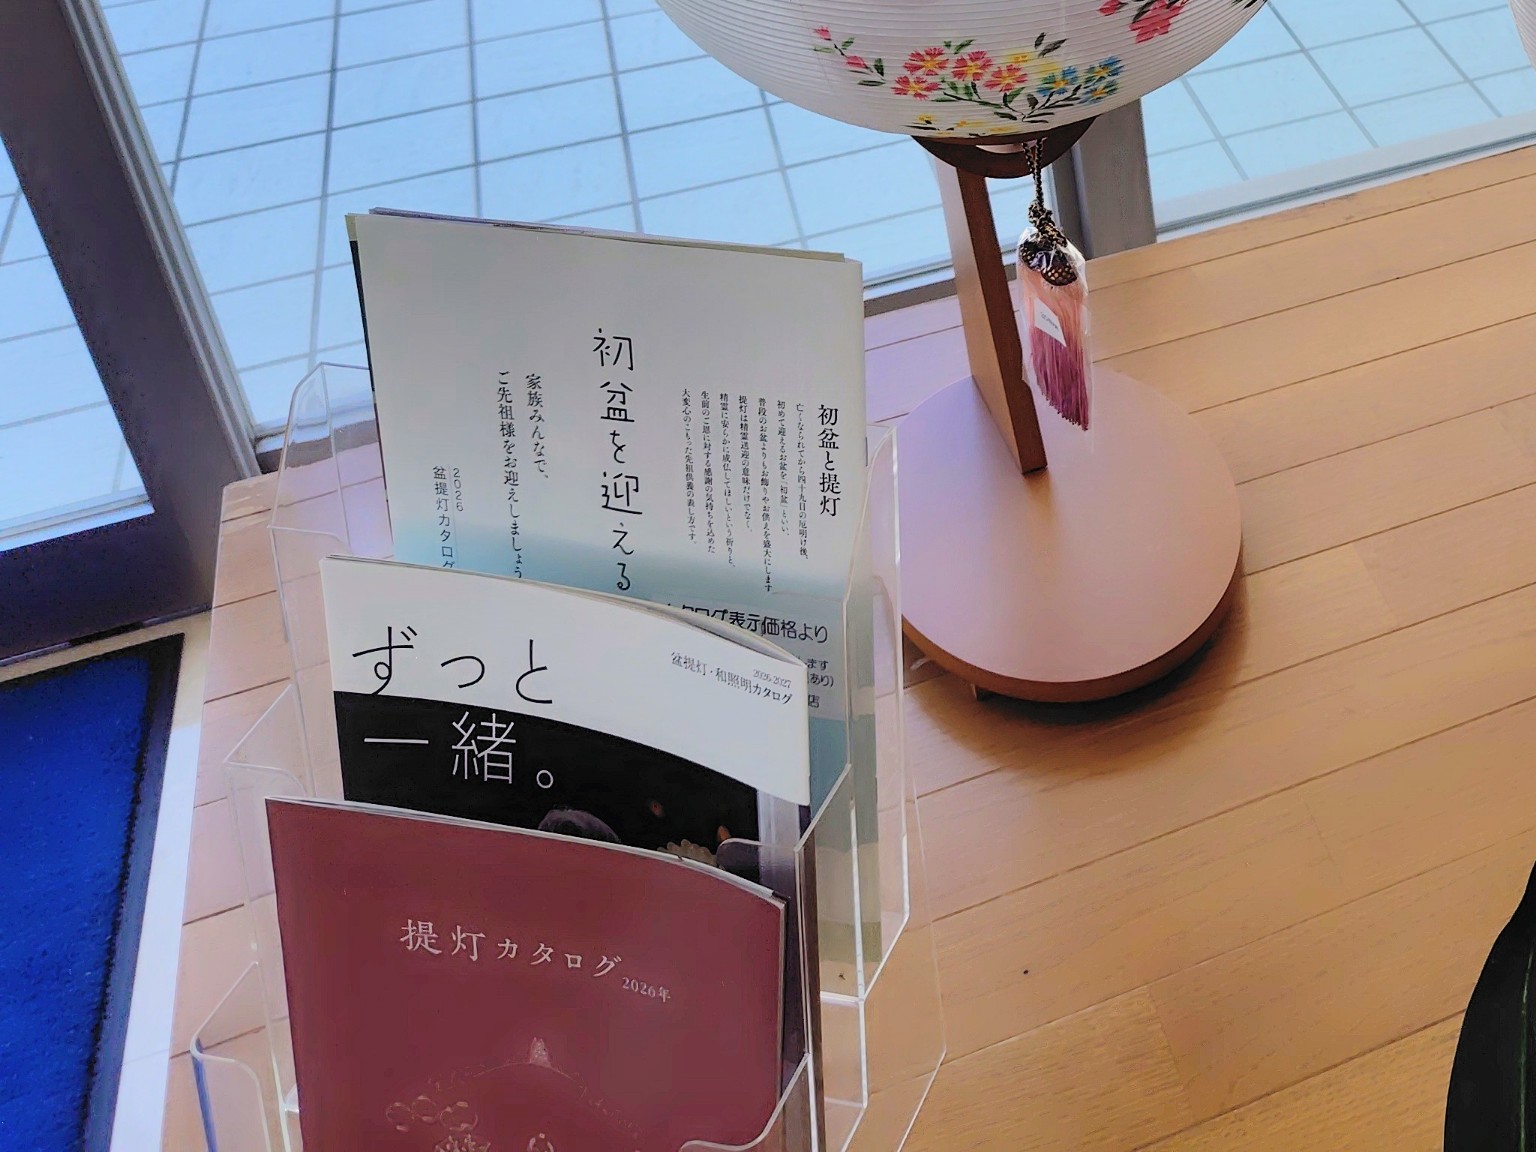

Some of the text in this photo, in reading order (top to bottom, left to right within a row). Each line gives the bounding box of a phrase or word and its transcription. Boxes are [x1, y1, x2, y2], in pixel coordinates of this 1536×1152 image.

[525, 372, 550, 479] 家族みんなで、
[592, 326, 643, 591] 初盆を迎える
[817, 403, 842, 518] 初盆と提灯
[452, 467, 464, 512] 2026
[352, 625, 553, 705] ずっと
[363, 710, 554, 790] 一緒。
[400, 918, 672, 1004] 提灯カタログ 2026年
